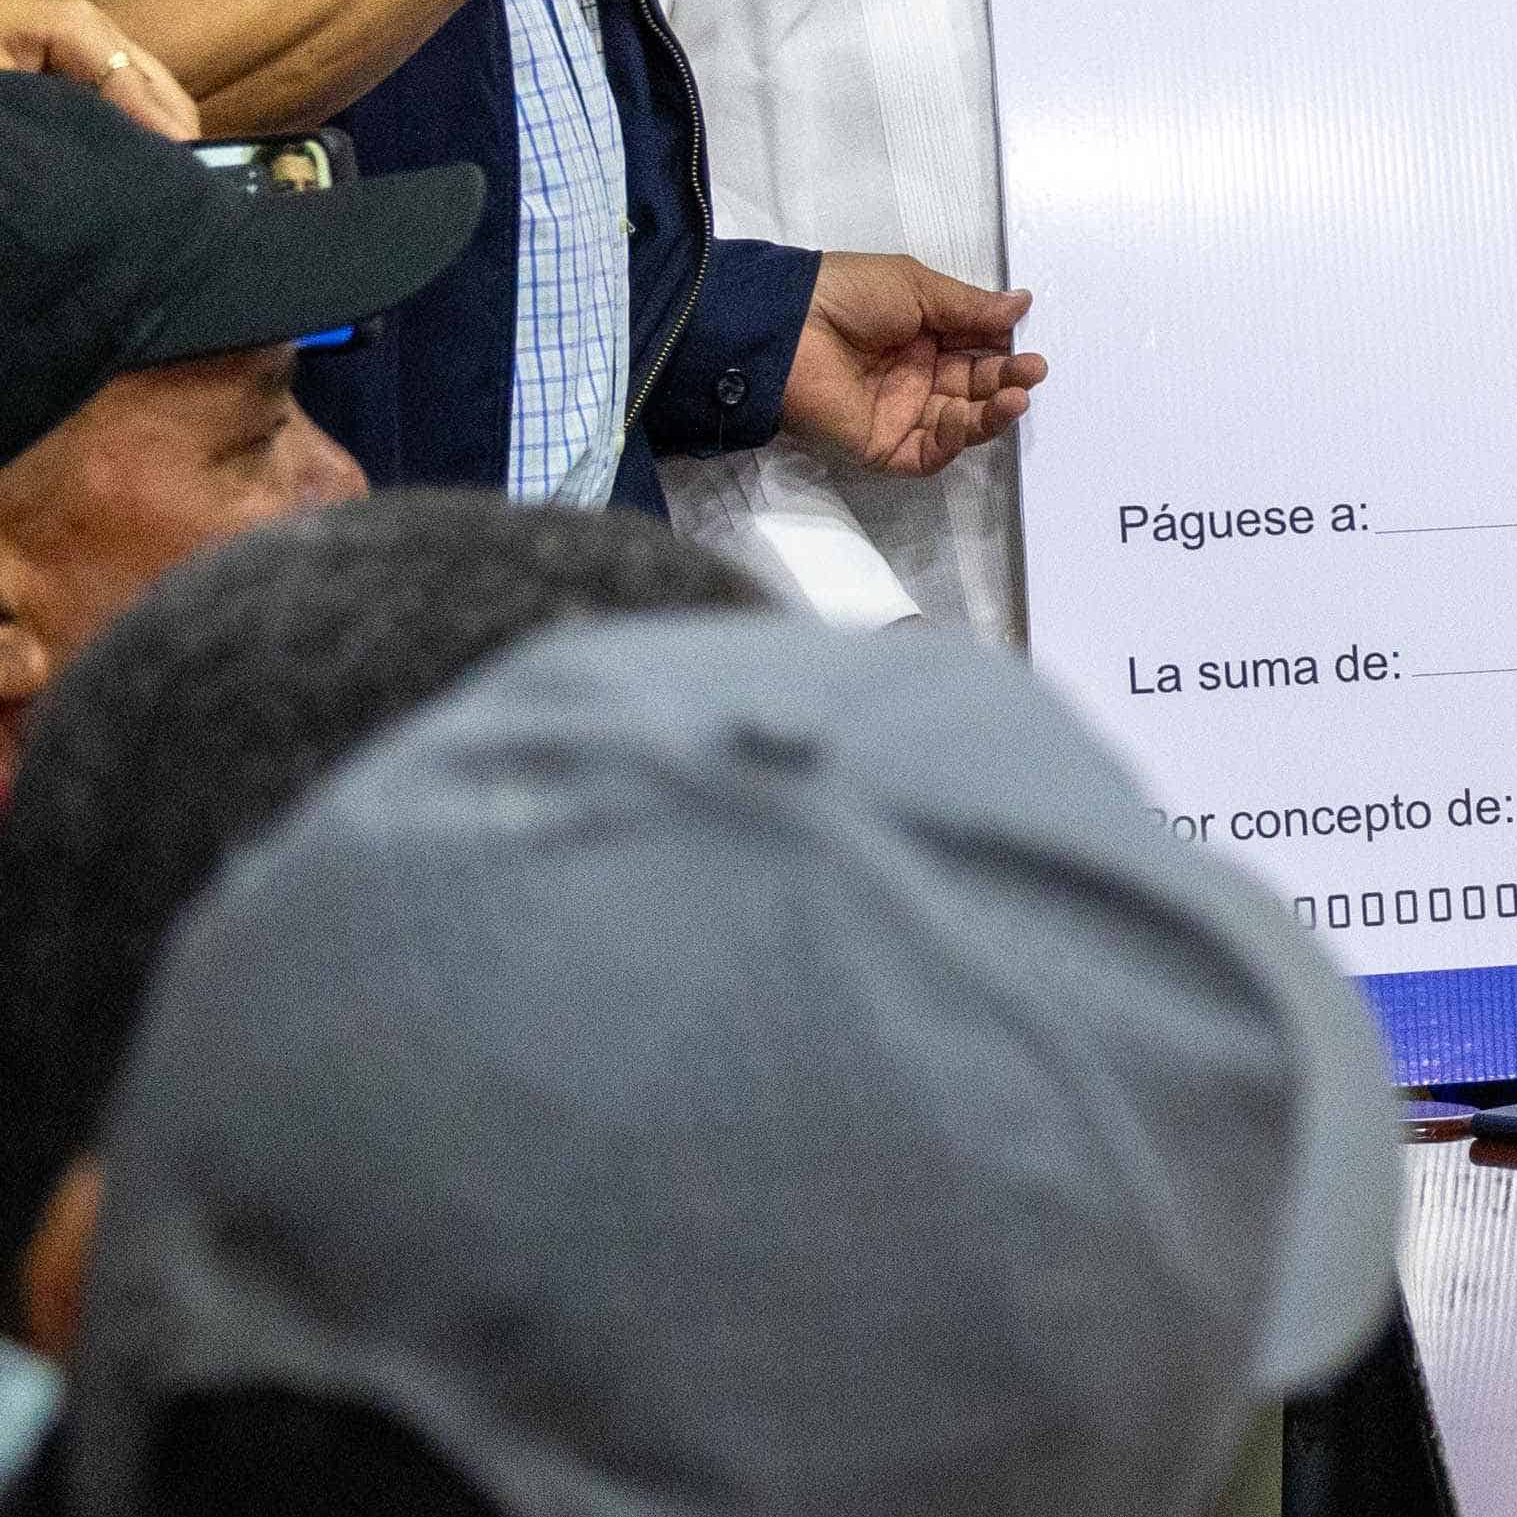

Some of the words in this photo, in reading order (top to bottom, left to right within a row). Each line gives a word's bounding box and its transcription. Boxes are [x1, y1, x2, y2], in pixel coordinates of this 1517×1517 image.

[1119, 501, 1314, 552] Páguese
[1331, 502, 1369, 533] a:
[1129, 657, 1182, 696] La
[1198, 656, 1319, 692] suma
[1335, 643, 1401, 684] de:
[1230, 793, 1431, 843] concepto
[1448, 787, 1513, 828] de:
